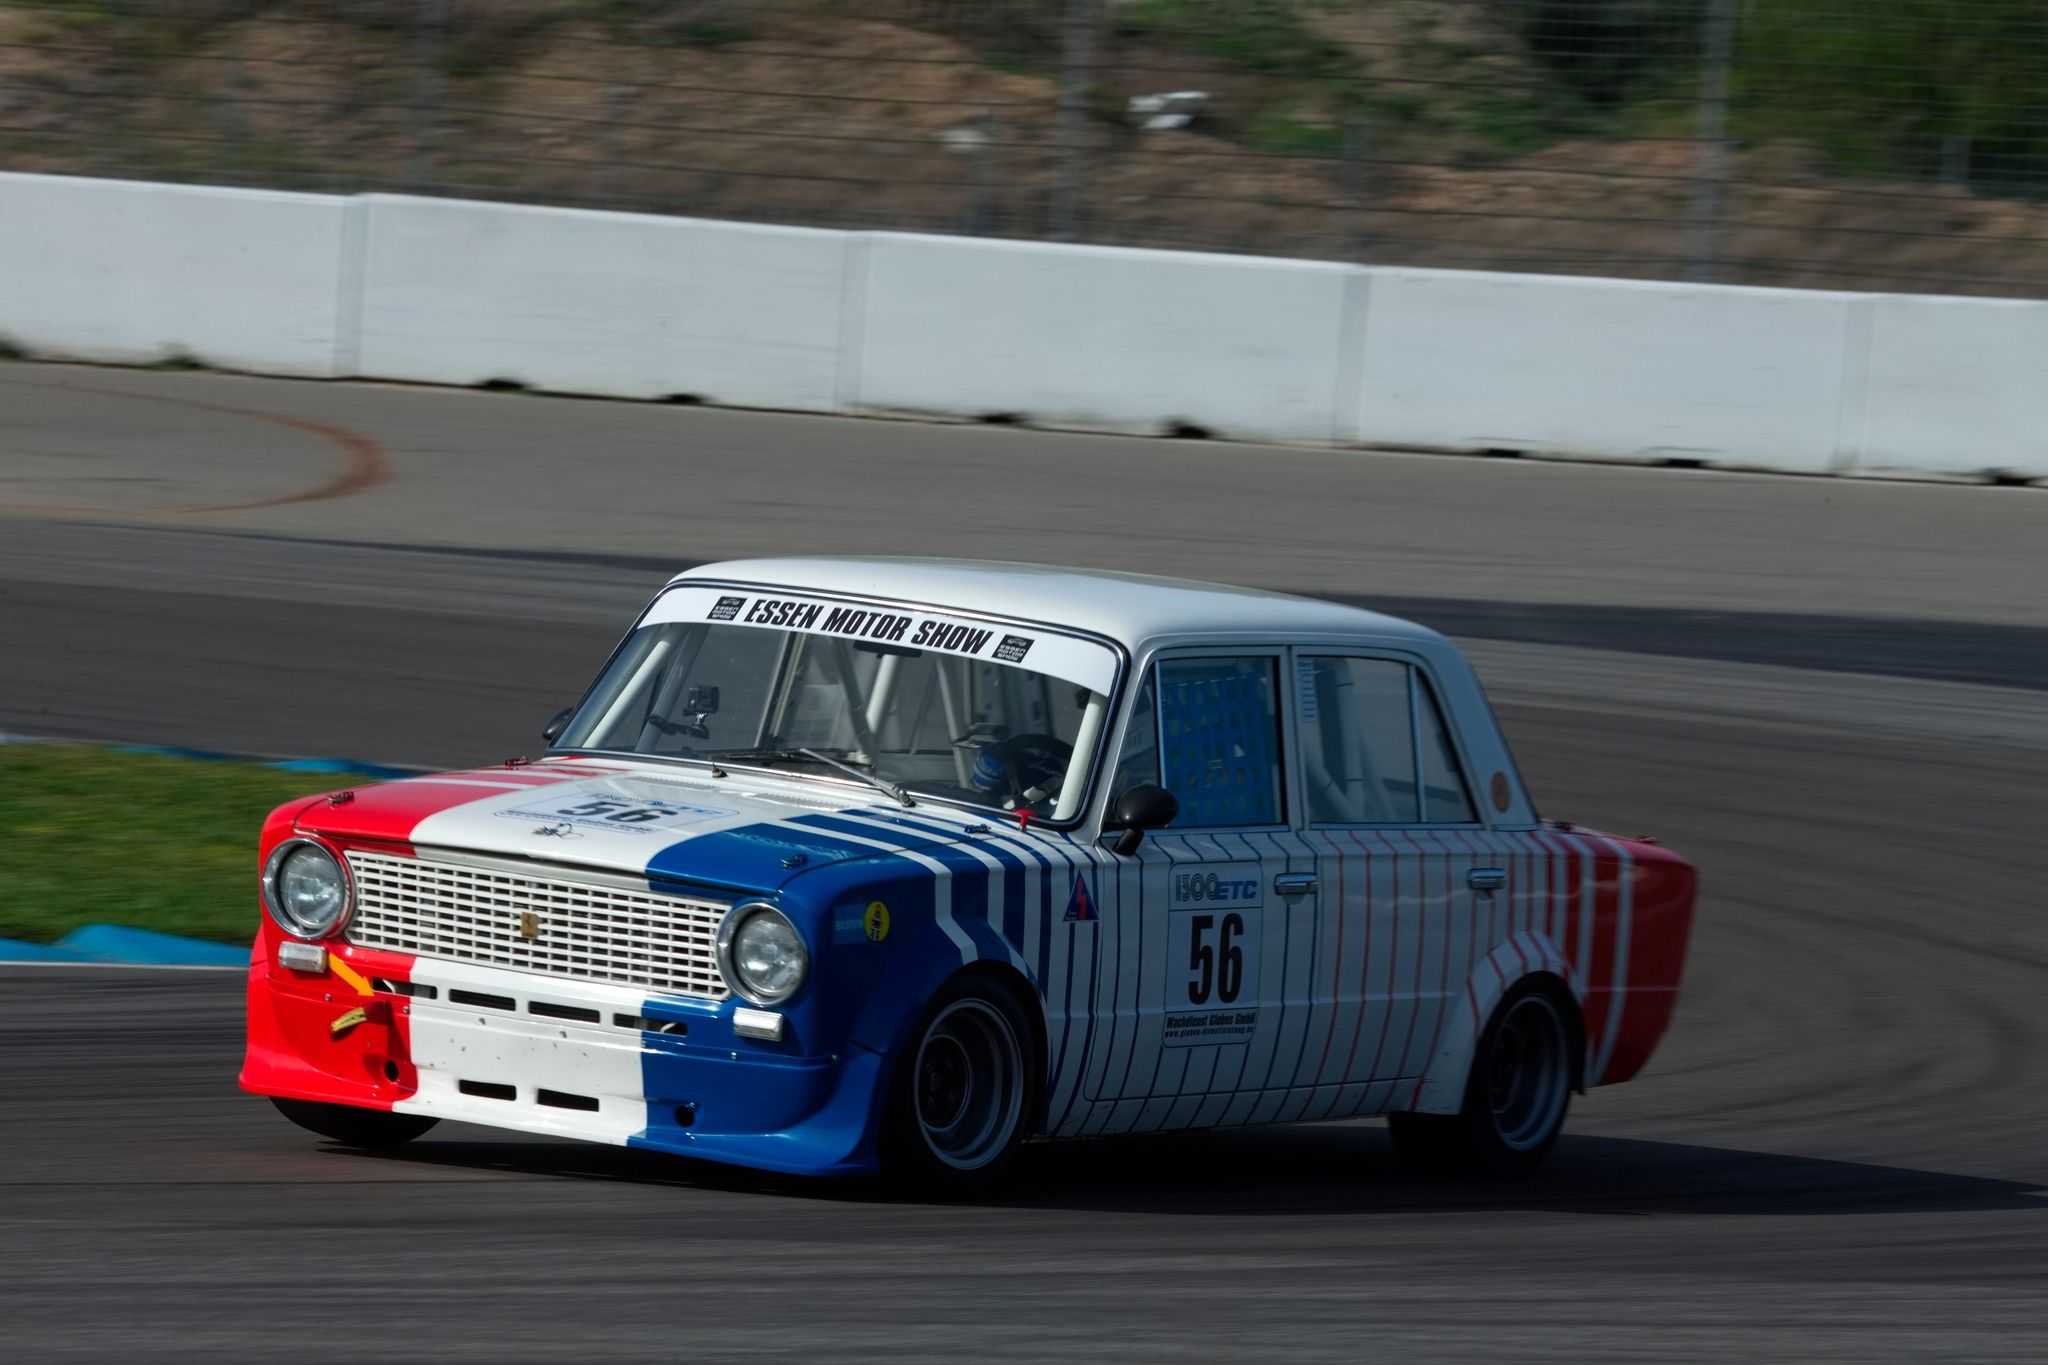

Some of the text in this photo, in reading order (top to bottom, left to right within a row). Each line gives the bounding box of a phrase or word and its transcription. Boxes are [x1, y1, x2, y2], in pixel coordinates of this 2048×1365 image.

[744, 599, 994, 654] ESSEN MOTOR SHOW
[1000, 645, 1026, 653] ESSEN
[557, 801, 678, 822] 56
[1188, 913, 1244, 1005] 56
[1167, 1015, 1208, 1028] Wachdienst
[1235, 1013, 1256, 1025] GmbH
